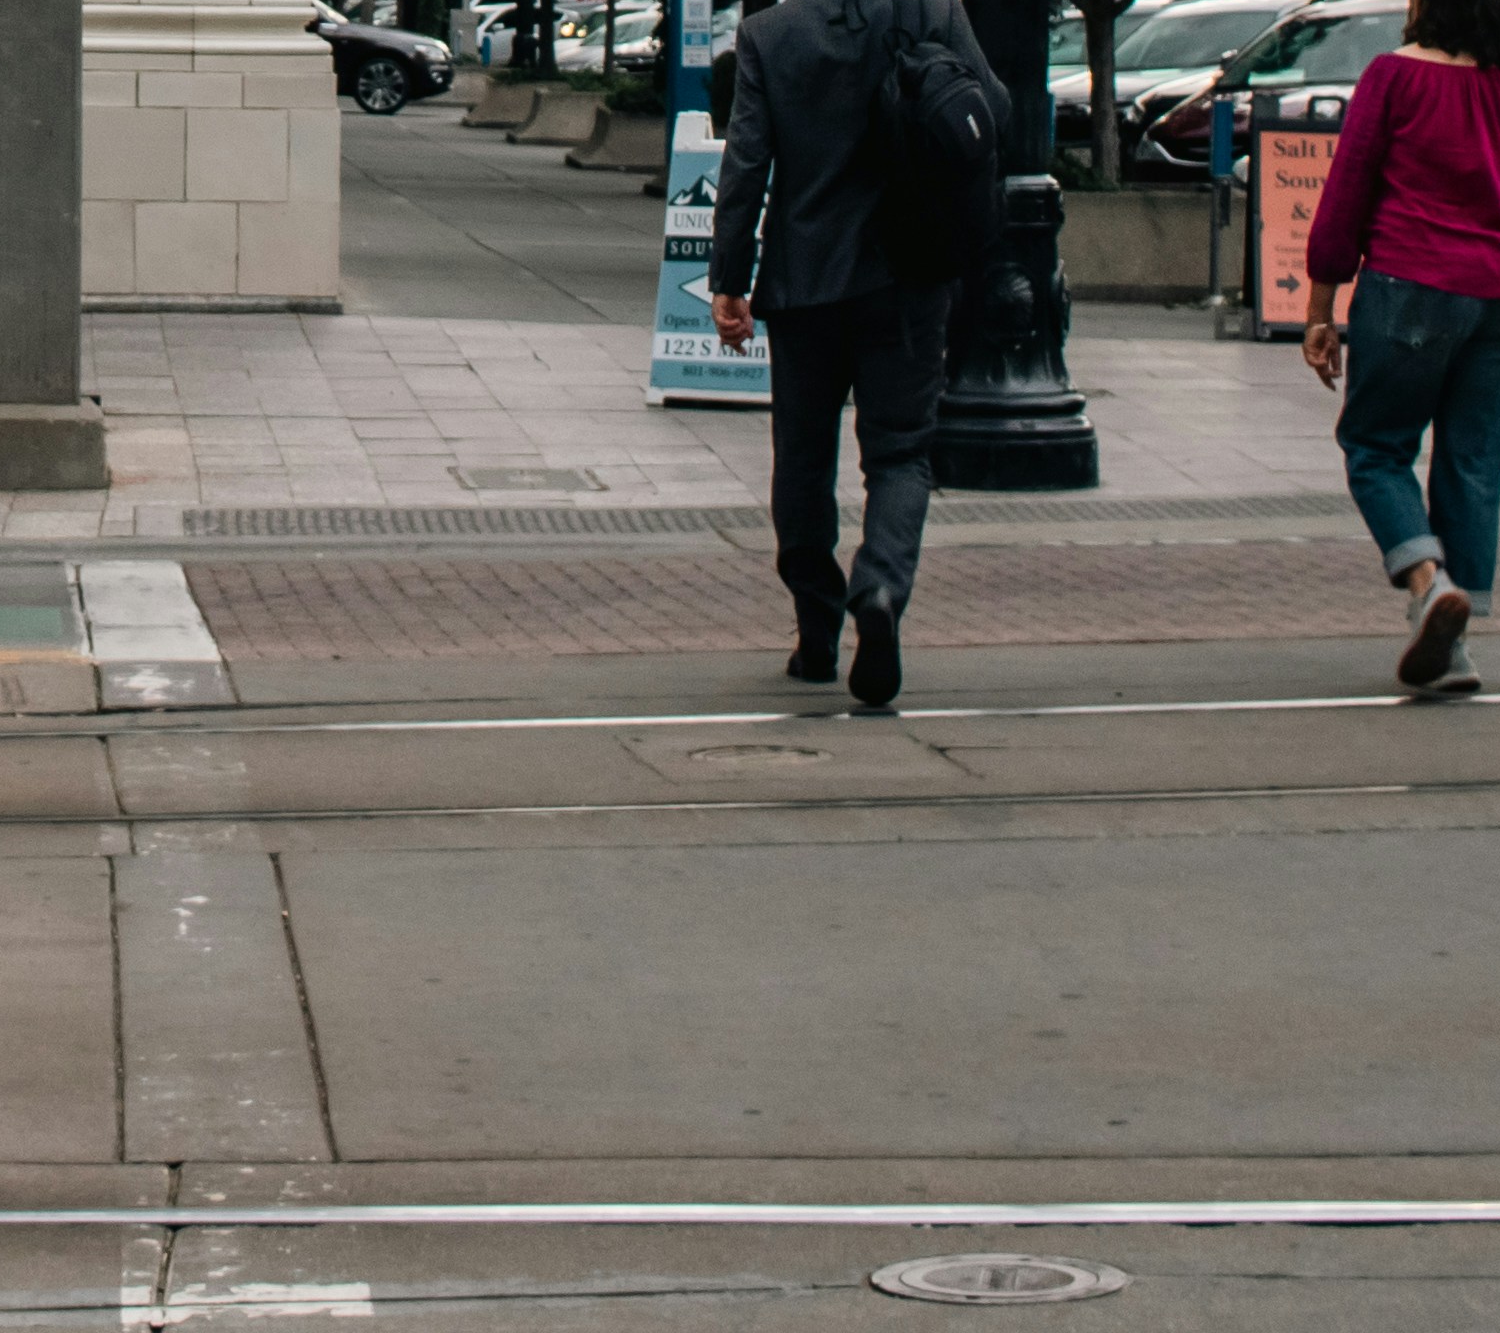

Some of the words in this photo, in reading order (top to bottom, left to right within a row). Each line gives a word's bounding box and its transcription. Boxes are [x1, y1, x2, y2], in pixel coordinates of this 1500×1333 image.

[1273, 138, 1317, 159] Salt
[1291, 202, 1311, 221] &
[664, 314, 700, 329] Open
[663, 338, 695, 355] 122
[700, 339, 712, 356] S
[717, 339, 767, 359] Min
